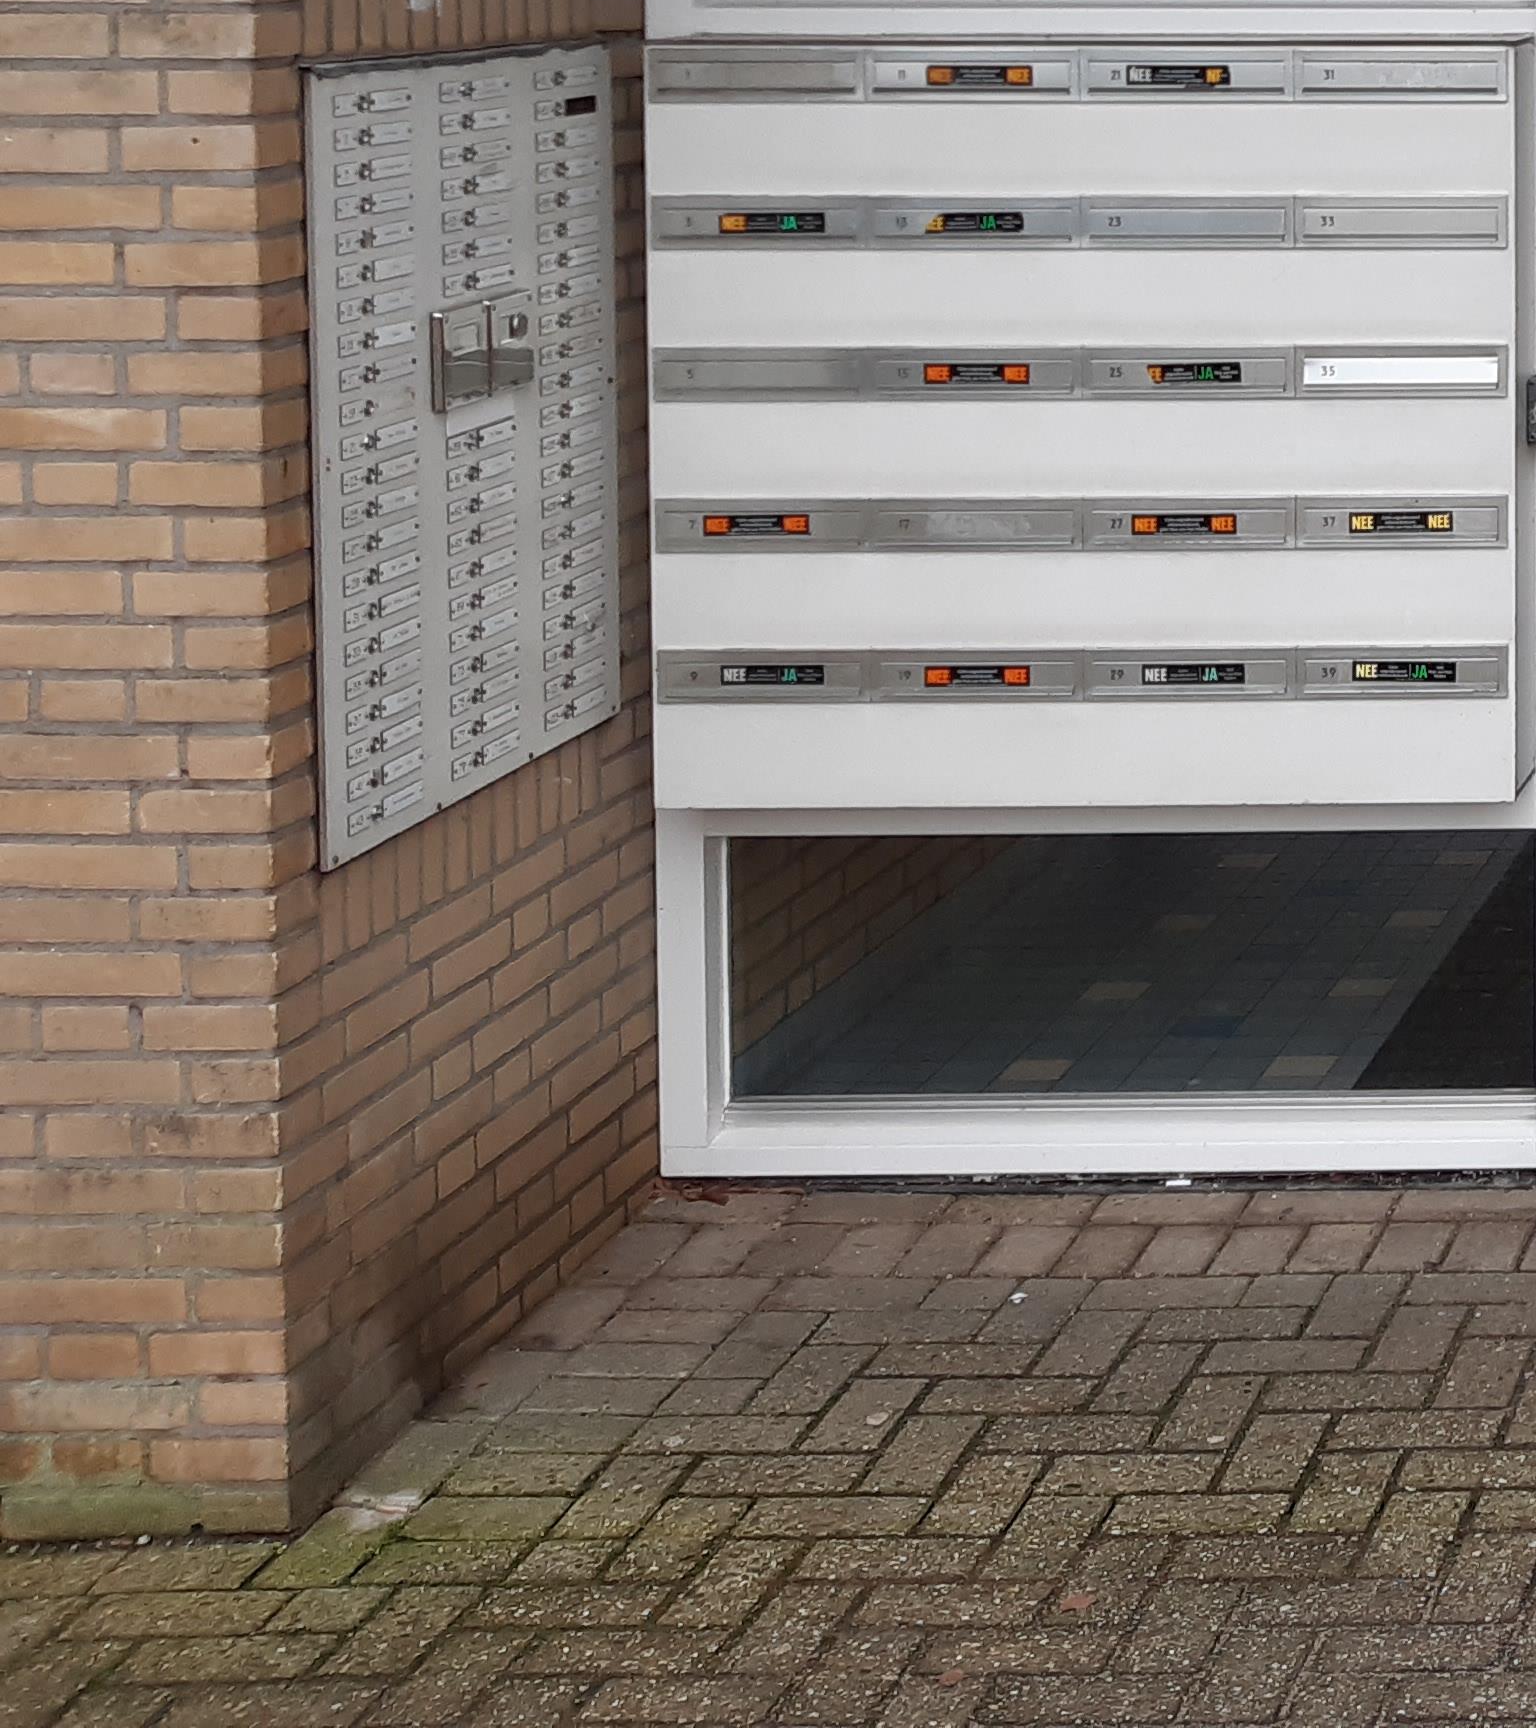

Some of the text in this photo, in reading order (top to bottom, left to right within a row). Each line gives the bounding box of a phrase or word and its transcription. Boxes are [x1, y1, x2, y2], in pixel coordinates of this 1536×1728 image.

[1110, 69, 1121, 81] 21
[1323, 69, 1334, 80] 31
[780, 216, 798, 230] JA
[979, 216, 996, 230] JA
[1107, 216, 1121, 227] 23
[1320, 216, 1335, 227] 33
[1109, 366, 1122, 378] 25
[1198, 366, 1214, 380] JA
[1321, 366, 1335, 376] 35
[1110, 517, 1123, 529] 27
[1134, 518, 1157, 533] NEE
[1211, 517, 1234, 532] NEE
[1322, 516, 1335, 527] 37
[1352, 516, 1375, 530] NEE
[1427, 514, 1450, 529] NEE
[723, 668, 797, 683] NEE JA
[1144, 667, 1219, 682] NEE JA
[1321, 667, 1336, 678] 39
[1355, 664, 1428, 679] NEE JA
